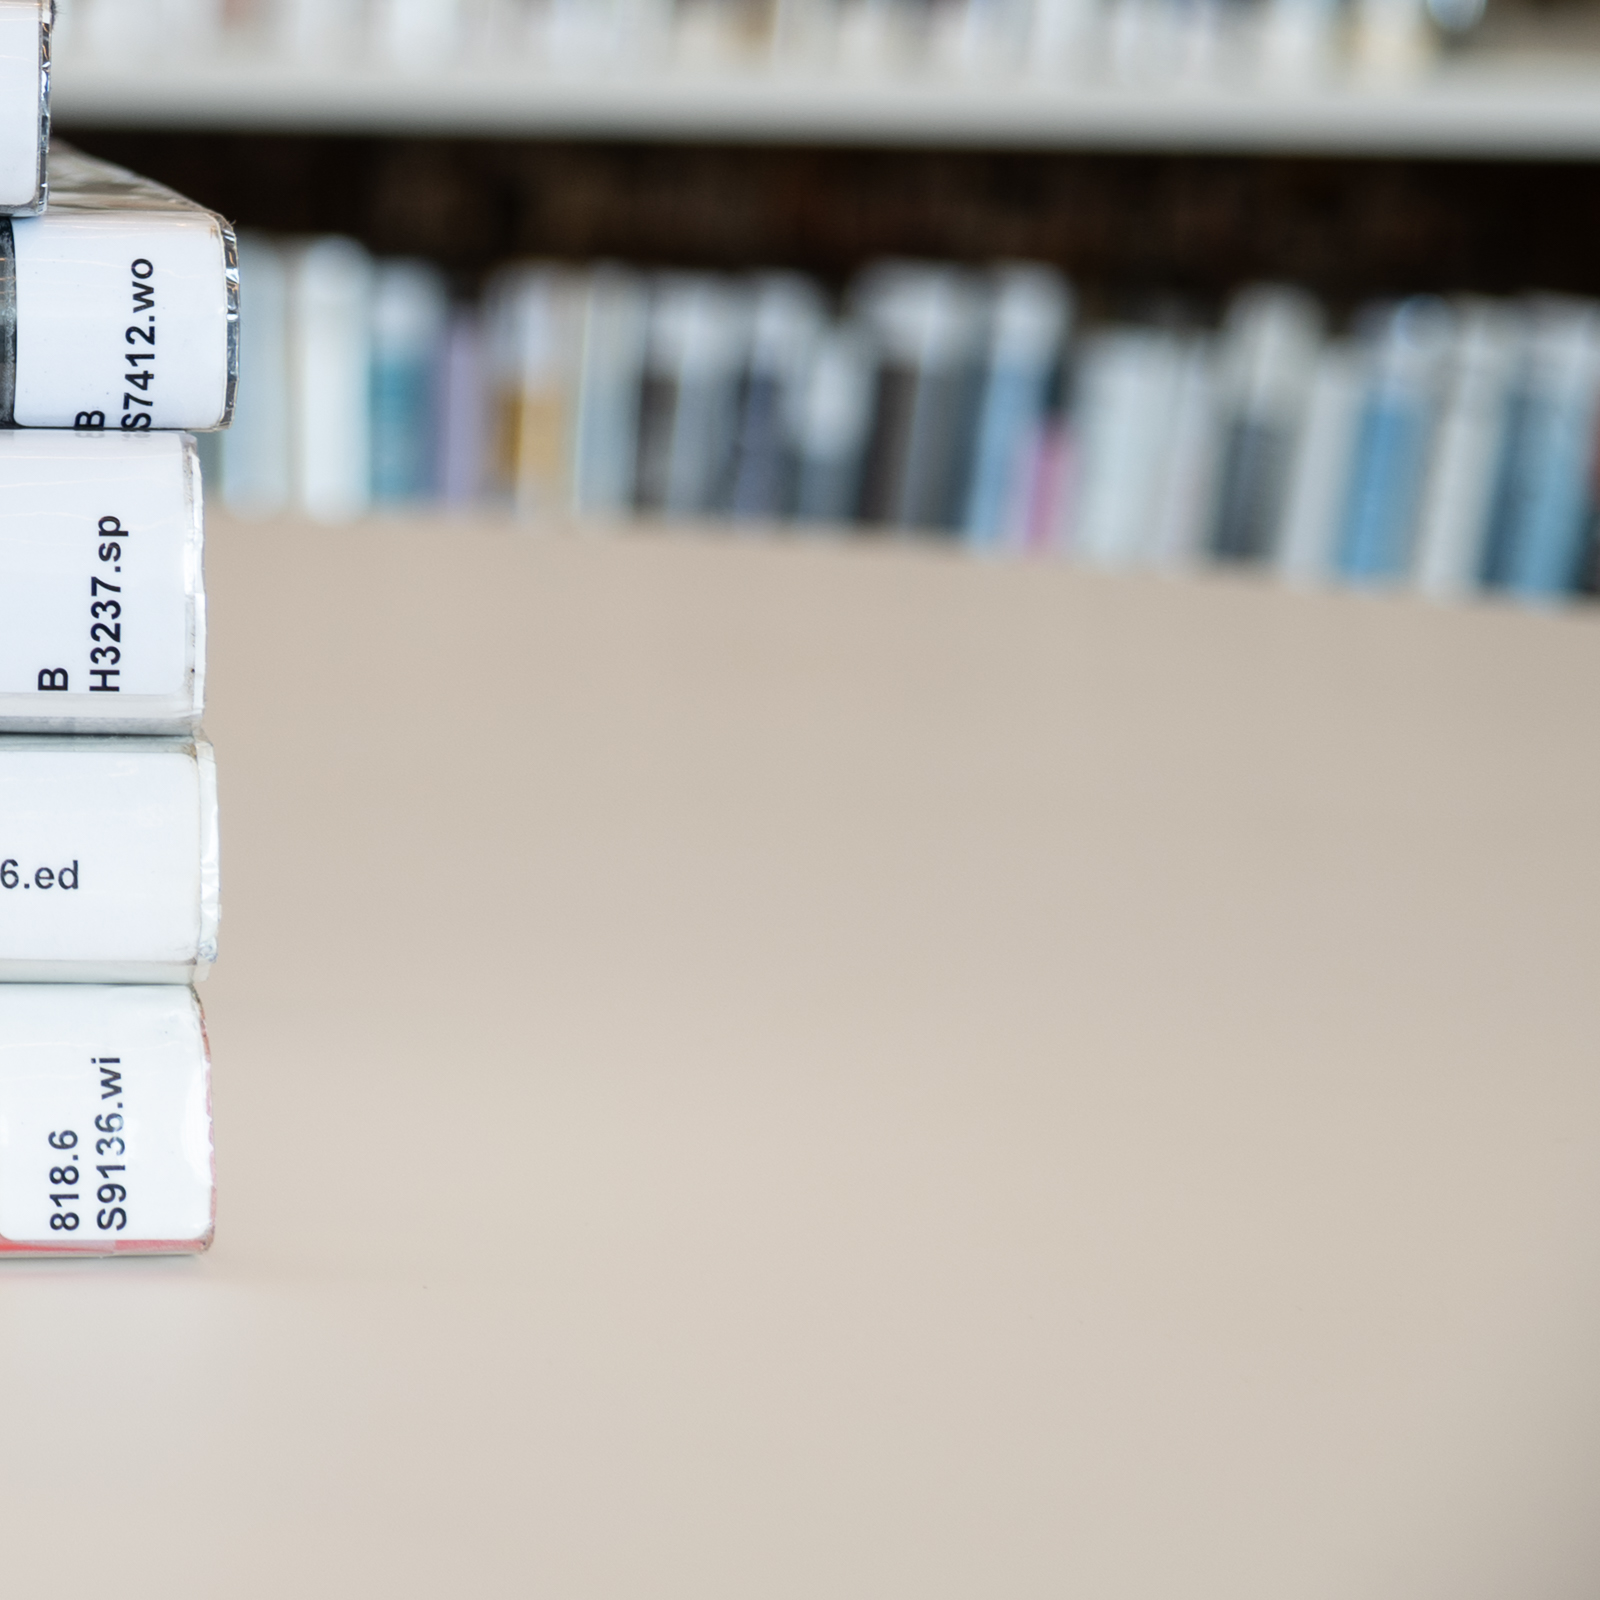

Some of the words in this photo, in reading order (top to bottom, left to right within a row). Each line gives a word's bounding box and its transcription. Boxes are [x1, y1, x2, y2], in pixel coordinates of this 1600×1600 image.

[120, 257, 156, 429] S7412.wo
[75, 410, 105, 429] B
[90, 516, 128, 692] H3237.sp
[38, 668, 68, 691] B
[49, 1129, 79, 1230] 818.6
[92, 1058, 127, 1230] S9136.wi
